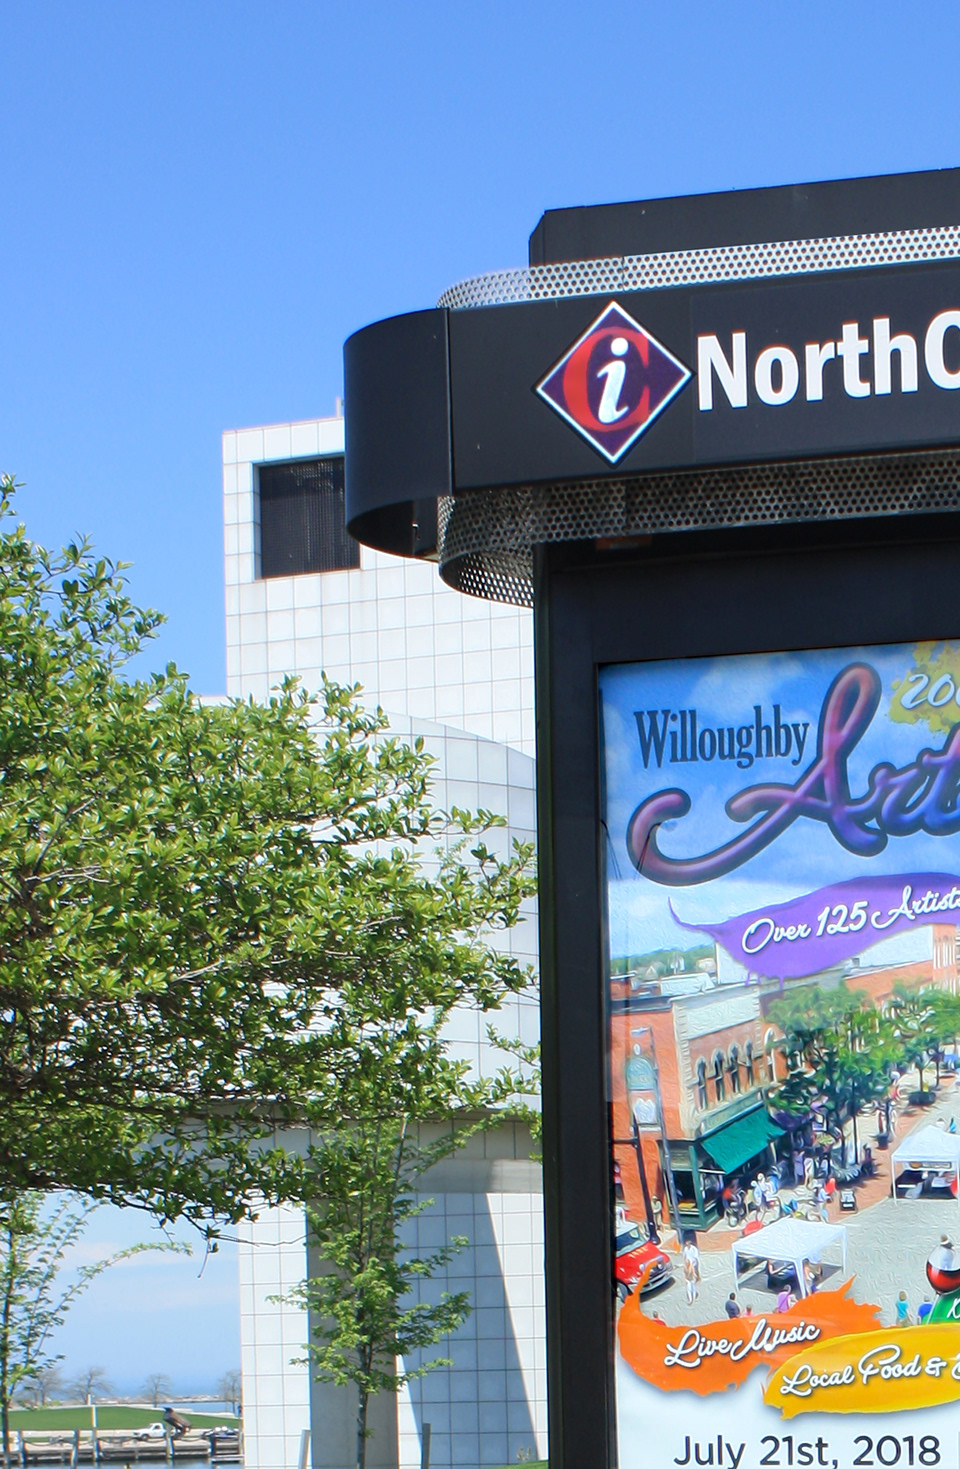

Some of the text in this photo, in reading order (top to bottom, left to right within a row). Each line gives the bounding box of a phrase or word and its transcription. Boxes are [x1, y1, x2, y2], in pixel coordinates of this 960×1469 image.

[633, 704, 810, 769] Willoughby
[742, 918, 811, 954] Over
[816, 900, 870, 937] 125
[664, 1318, 820, 1368] Live Music
[780, 1364, 855, 1397] Local
[858, 1344, 922, 1384] Food
[925, 1357, 947, 1378] &
[853, 1435, 941, 1467] 2018
